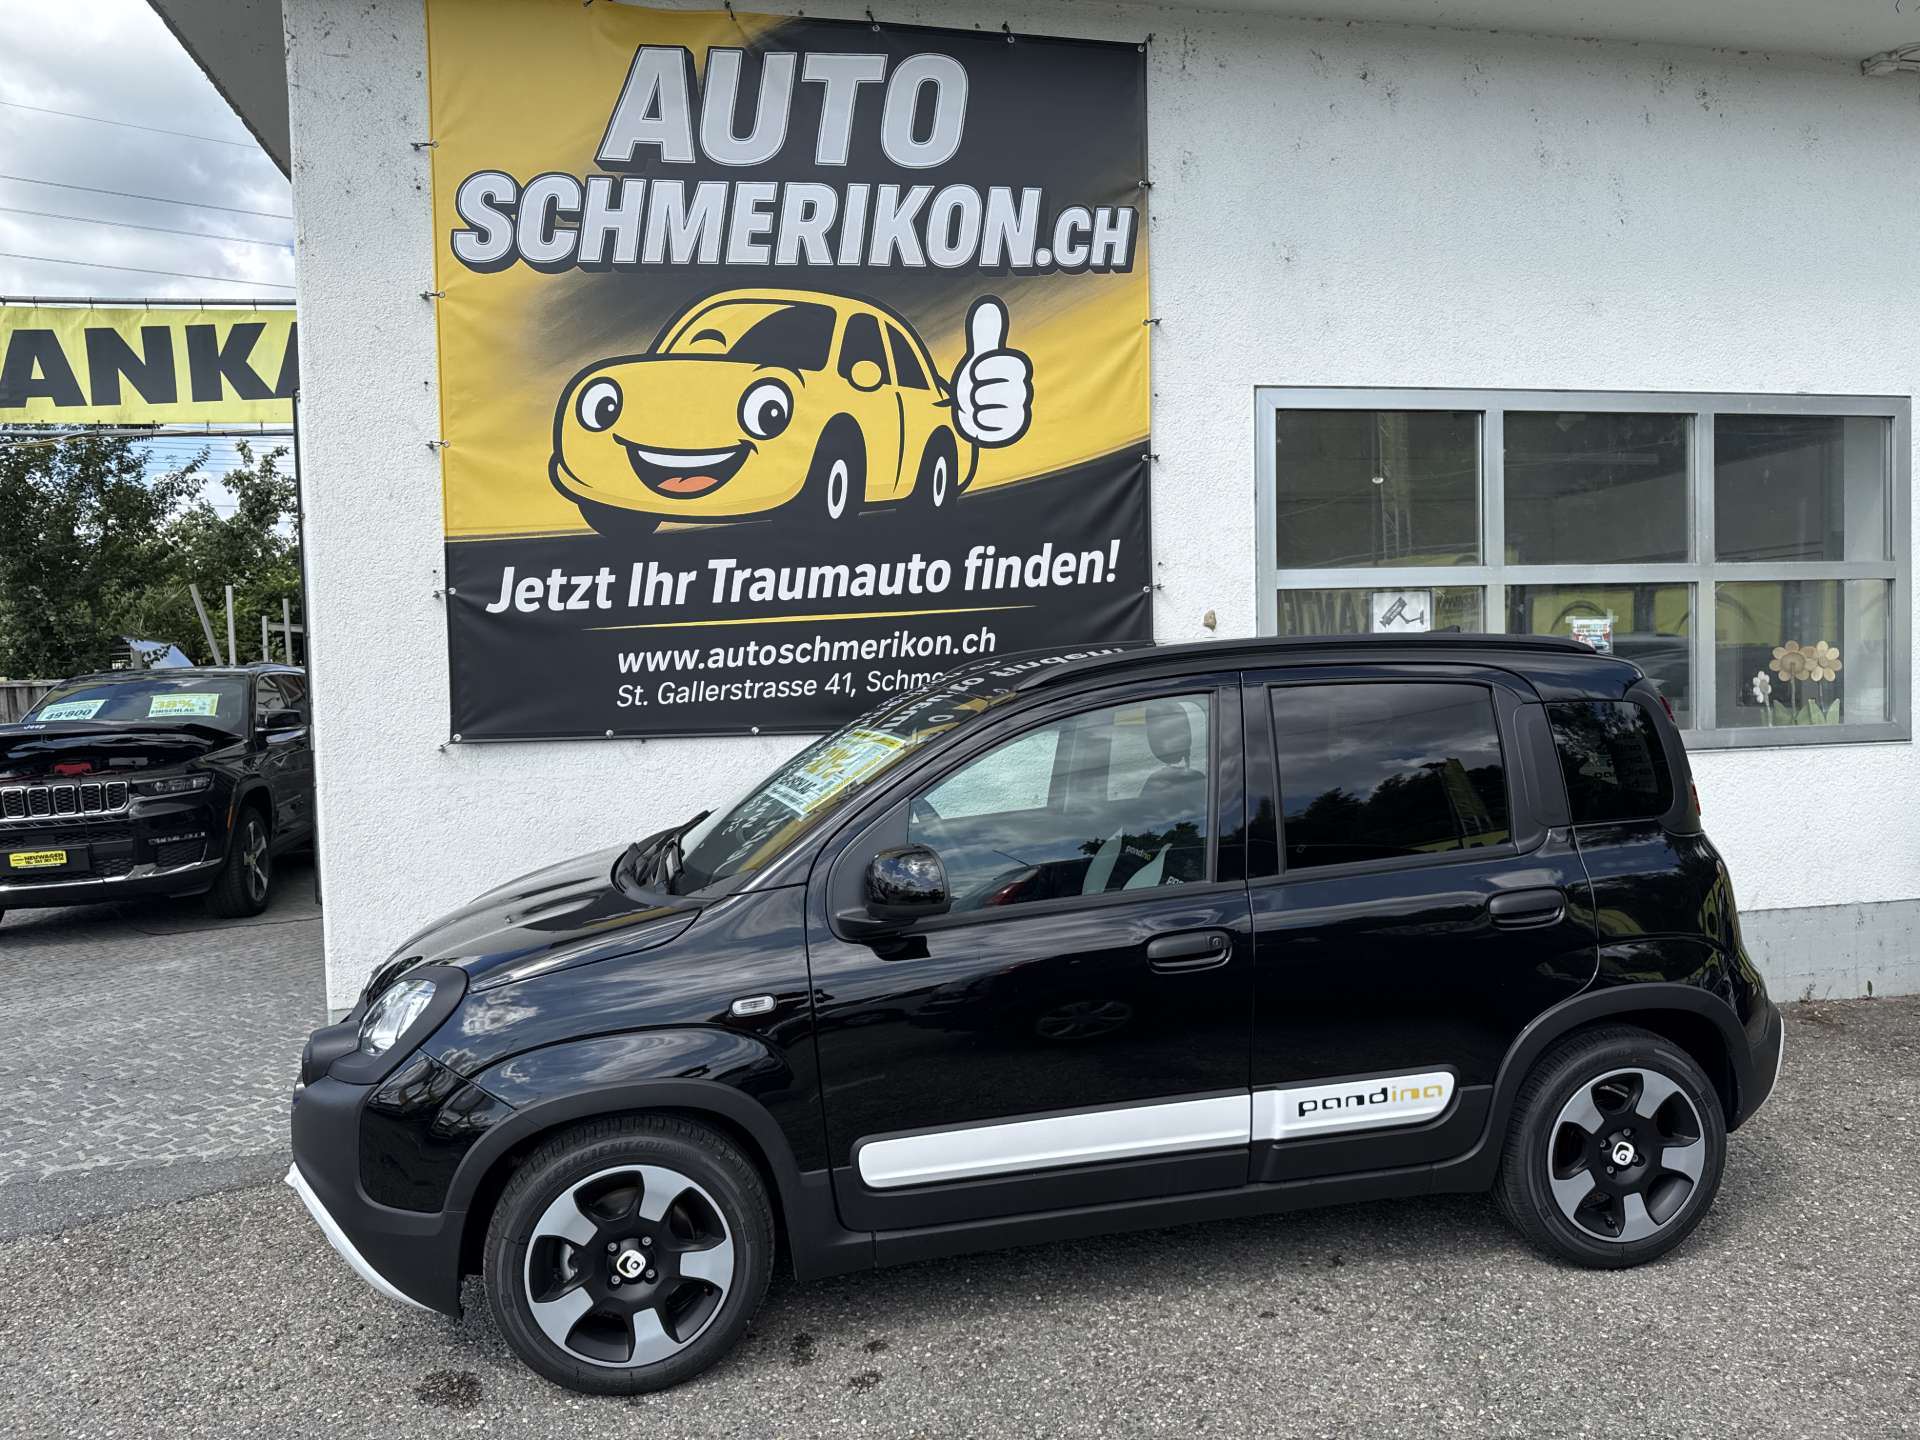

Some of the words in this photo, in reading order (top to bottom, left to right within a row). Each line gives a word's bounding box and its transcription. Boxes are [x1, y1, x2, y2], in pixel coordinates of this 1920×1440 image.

[597, 45, 968, 170] AUTO
[452, 171, 1136, 269] SCHMERIKON.CH
[0, 321, 299, 408] ANK
[485, 566, 616, 613] Jetzt
[627, 561, 697, 607] Ihr
[707, 553, 951, 604] Traumauto
[964, 539, 1121, 591] finden!
[617, 626, 996, 673] www.autoschmerikon.ch
[616, 684, 649, 707] St.
[657, 679, 818, 705] Gallerstrasse
[824, 672, 857, 698] 41,
[1298, 1085, 1443, 1117] pandina
